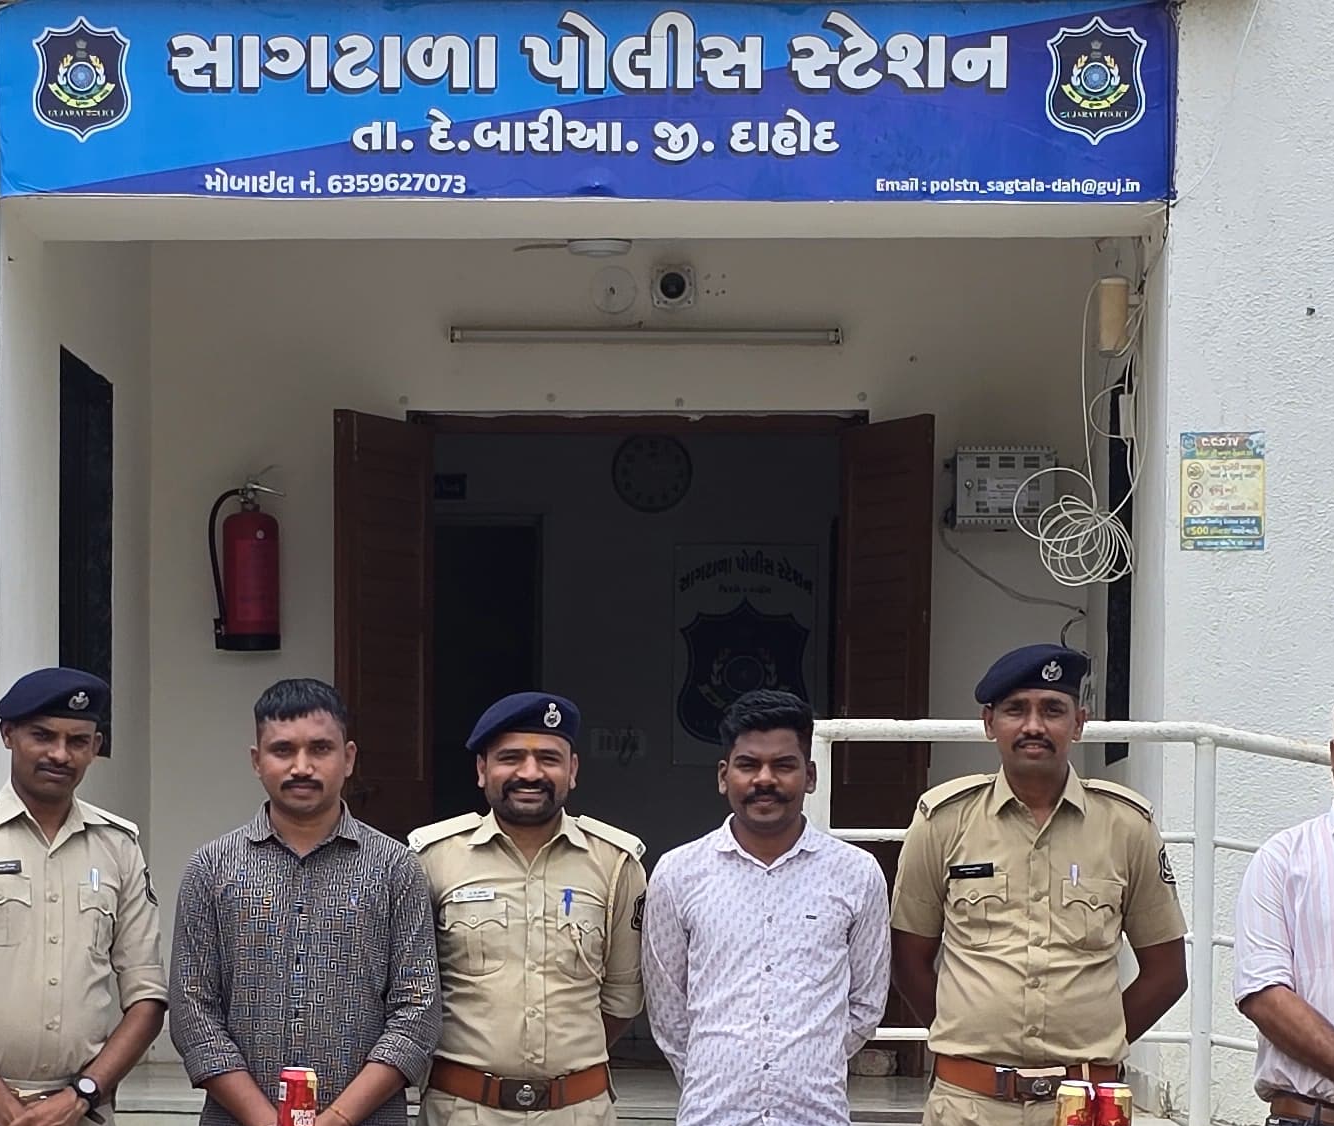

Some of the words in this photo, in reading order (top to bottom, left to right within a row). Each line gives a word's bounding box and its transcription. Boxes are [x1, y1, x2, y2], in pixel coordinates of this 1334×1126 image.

[170, 33, 497, 90] સાગટાળા
[523, 10, 763, 90] પોલીસ
[791, 10, 1009, 90] સ્ટેશન
[352, 119, 414, 152] તા.
[426, 107, 639, 153] દે.બારીઆ.
[652, 121, 716, 162] જી.
[729, 108, 840, 154] દાહોદ
[300, 170, 322, 194] નં.
[327, 173, 467, 194] 6359627073
[875, 178, 919, 192] Email
[930, 178, 1141, 195] polstn_sagtala-dah@guj.in
